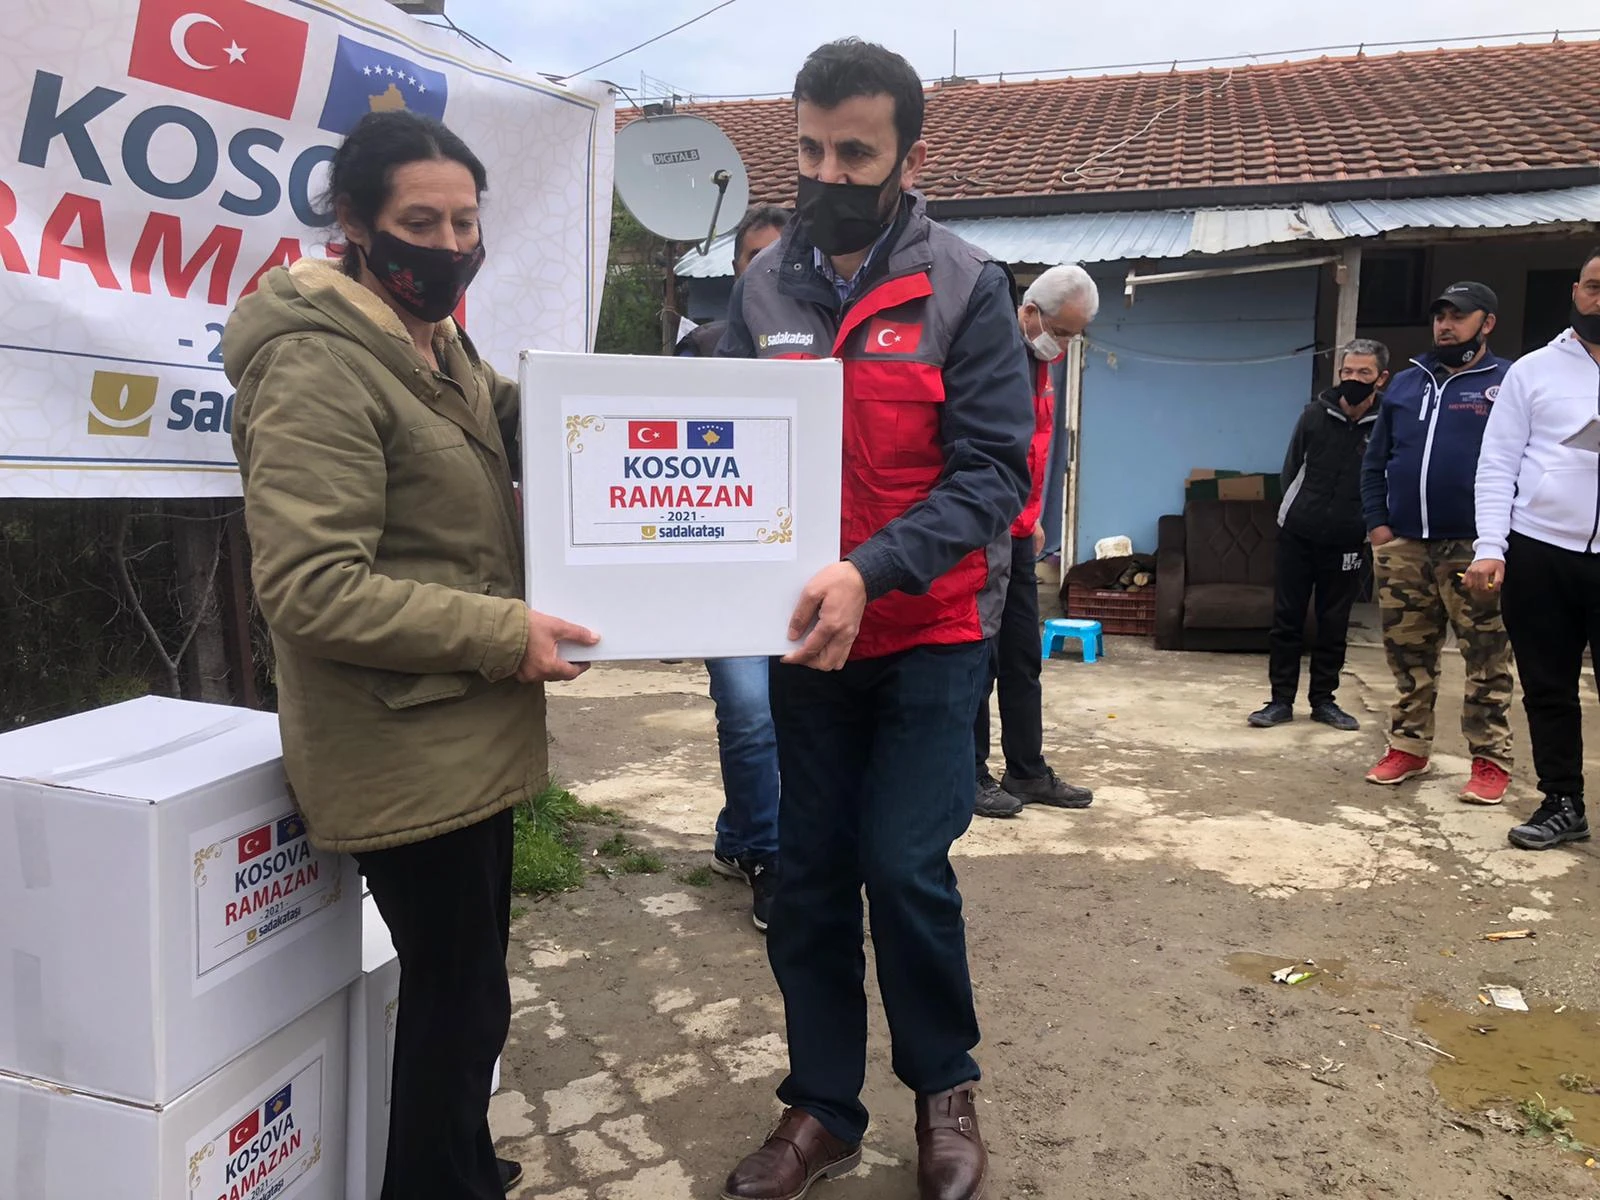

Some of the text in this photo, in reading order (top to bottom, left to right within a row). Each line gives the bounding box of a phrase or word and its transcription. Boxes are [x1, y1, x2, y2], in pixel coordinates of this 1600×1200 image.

[18, 69, 341, 228] KOSO
[653, 150, 699, 165] DIGITALB
[623, 456, 740, 478] KOSOVA
[609, 484, 753, 508] RAMAZAN
[659, 524, 725, 539] sadakataşı
[235, 840, 311, 893] KOSOVA
[225, 861, 319, 926] RAMAZAN
[225, 1112, 294, 1184] KOSOVA
